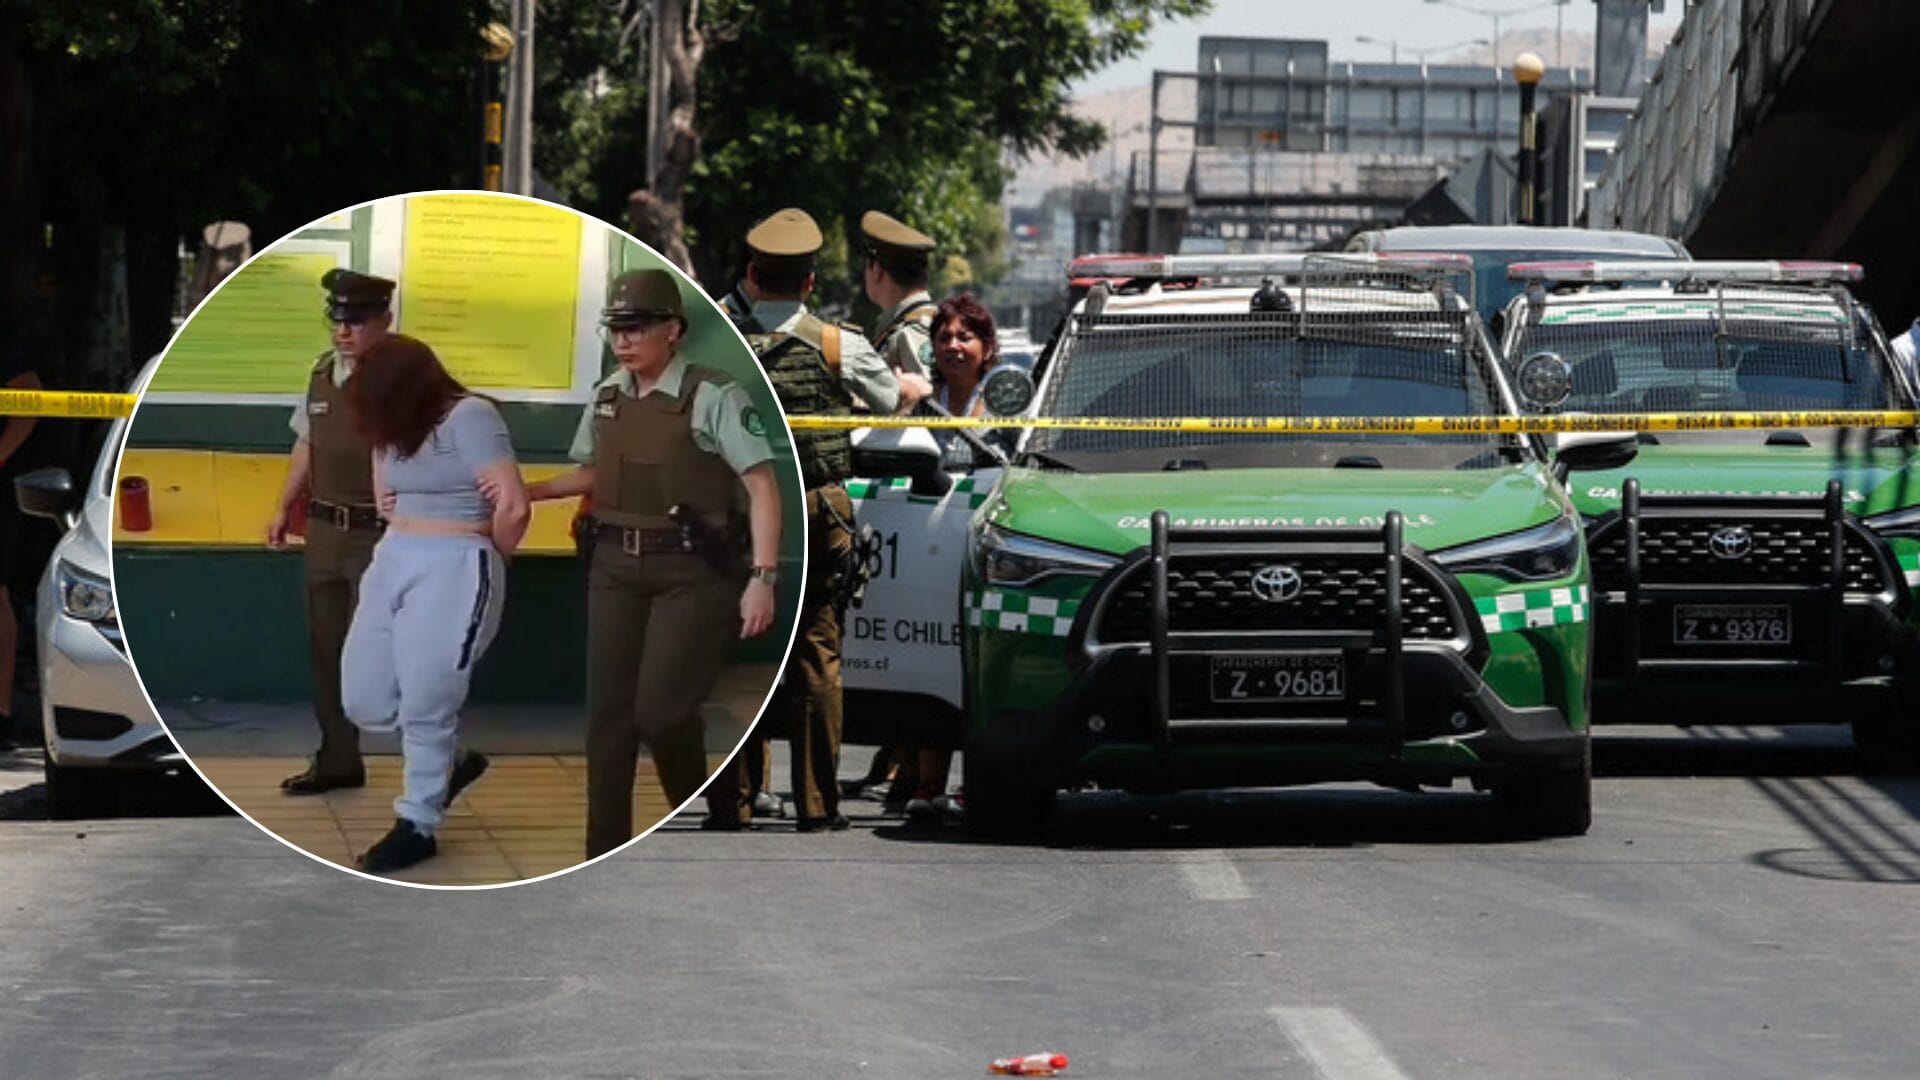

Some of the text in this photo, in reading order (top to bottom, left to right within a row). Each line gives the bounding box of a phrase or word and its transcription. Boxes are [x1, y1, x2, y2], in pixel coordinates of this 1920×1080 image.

[855, 617, 887, 641] DE
[894, 619, 961, 646] CHILE
[1682, 619, 1784, 640] Z 9376
[1231, 670, 1341, 697] Z 9681
